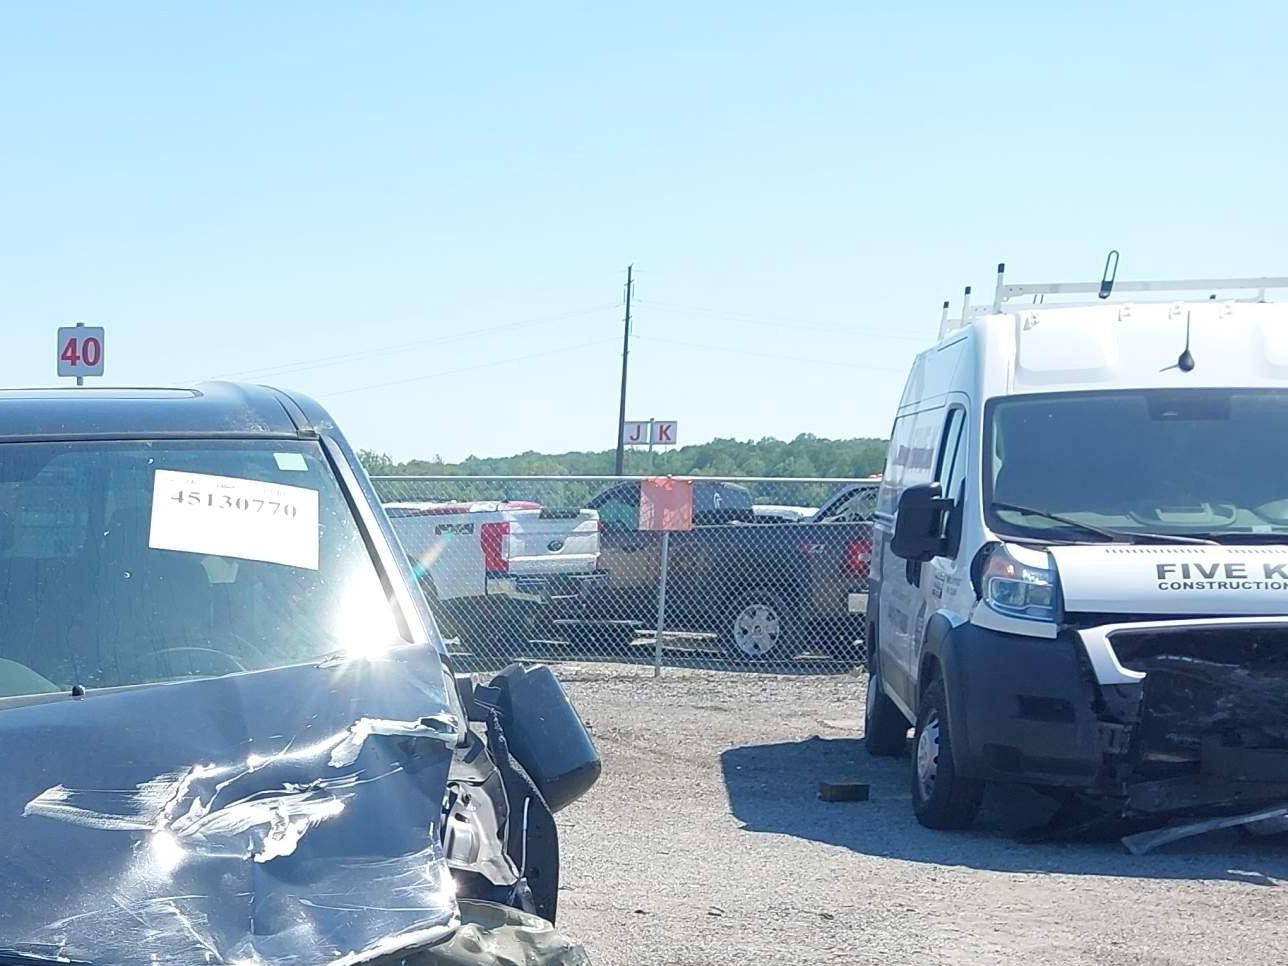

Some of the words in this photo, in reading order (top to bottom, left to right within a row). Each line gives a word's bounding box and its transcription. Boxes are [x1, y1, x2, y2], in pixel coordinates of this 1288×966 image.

[60, 336, 102, 367] 40
[629, 424, 641, 441] J
[659, 424, 672, 441] K
[170, 489, 297, 518] 45130770
[1156, 562, 1249, 580] FIVE
[1262, 562, 1288, 580] K
